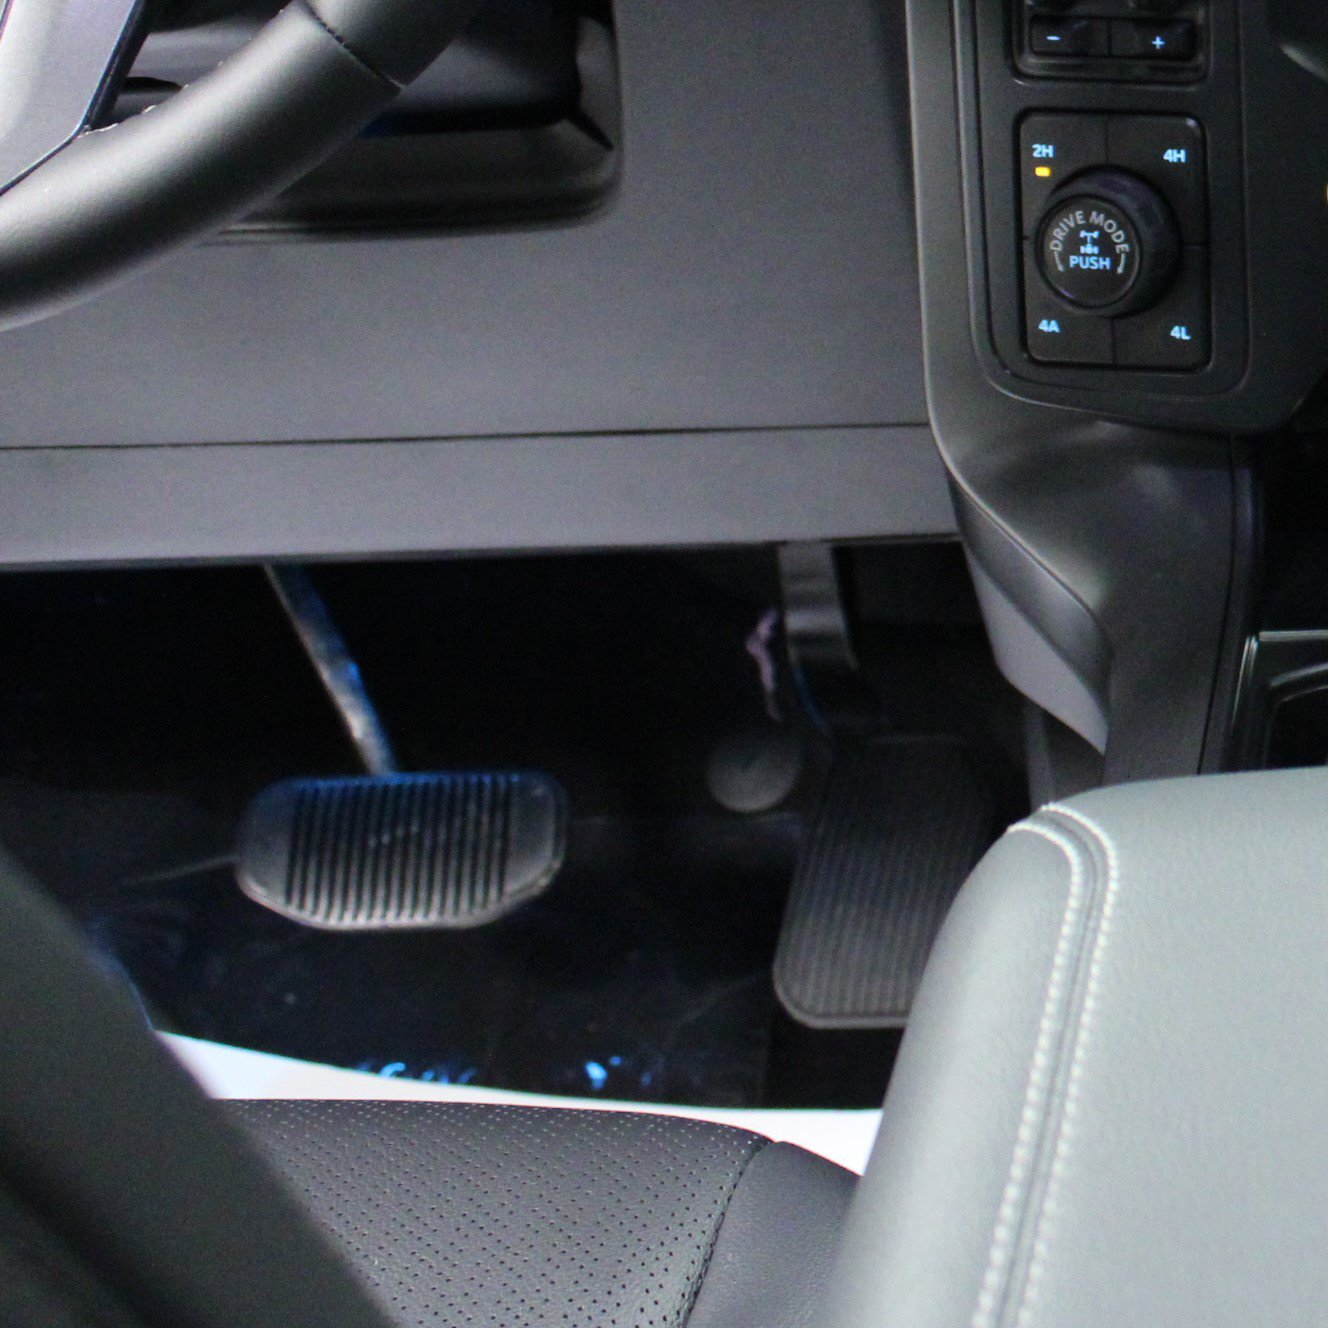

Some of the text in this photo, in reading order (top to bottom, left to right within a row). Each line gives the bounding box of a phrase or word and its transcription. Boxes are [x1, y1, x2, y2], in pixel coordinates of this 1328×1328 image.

[1032, 143, 1055, 158] 2H
[1162, 148, 1187, 163] 4H
[1049, 210, 1130, 254] DRIVE MODE
[1069, 255, 1111, 270] PUSH
[1038, 319, 1061, 333] 4A
[1170, 325, 1192, 341] 4L
